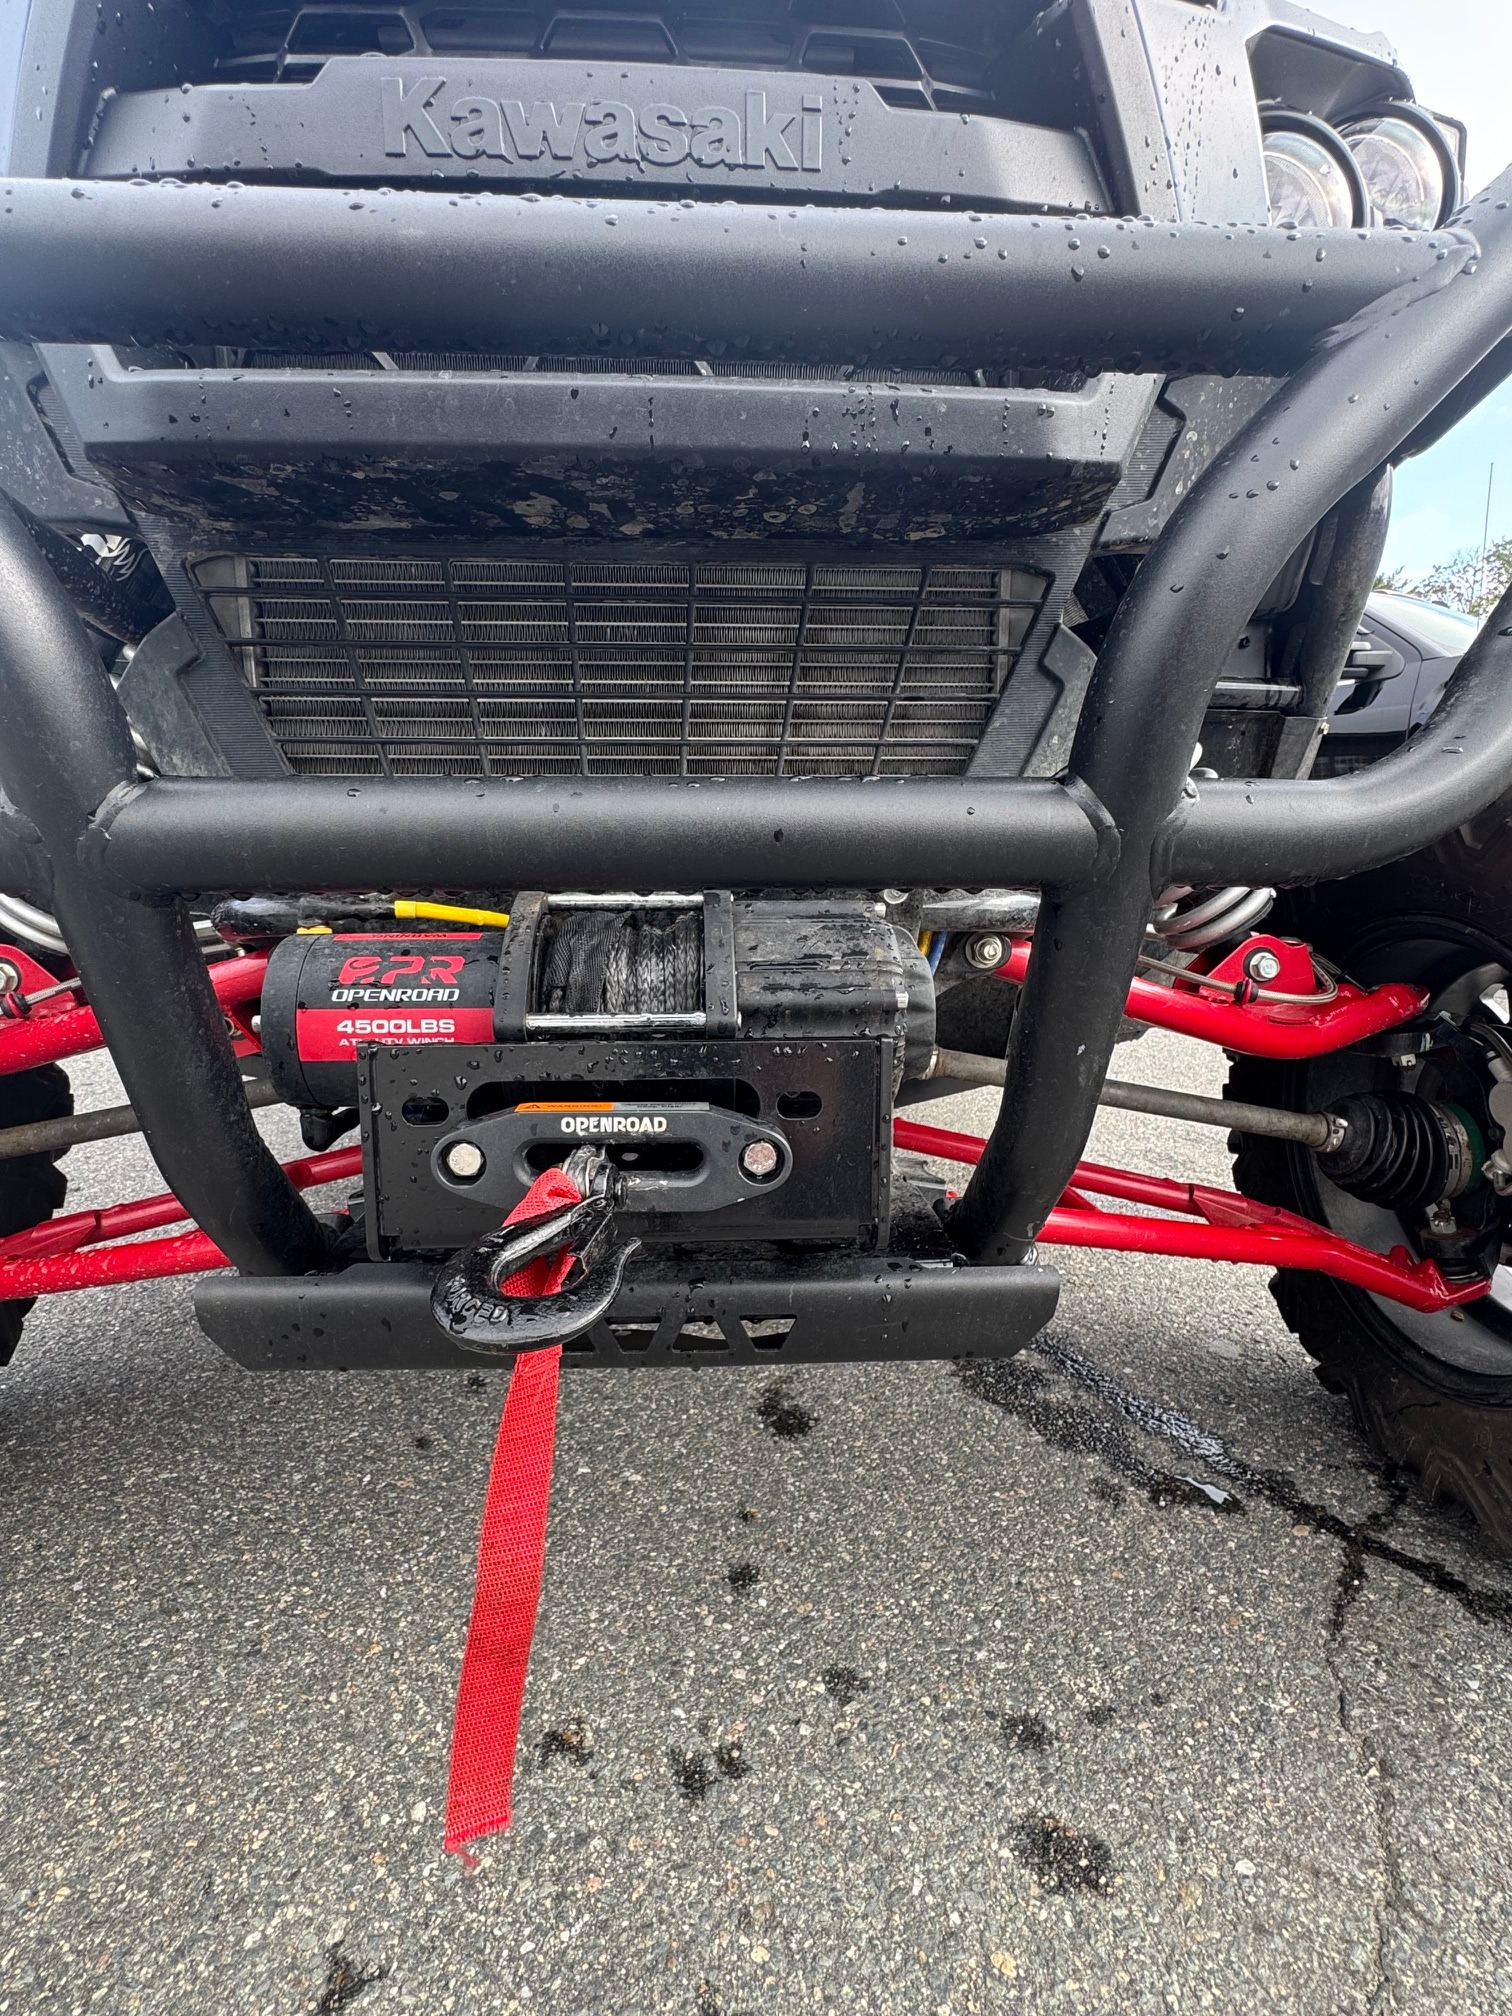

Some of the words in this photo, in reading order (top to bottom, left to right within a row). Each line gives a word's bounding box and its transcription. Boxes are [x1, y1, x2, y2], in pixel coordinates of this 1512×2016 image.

[380, 76, 823, 173] Kawasaki
[331, 988, 460, 1002] OPENROAD
[337, 1019, 456, 1034] 4500LBS
[560, 1117, 668, 1133] OPENROAD
